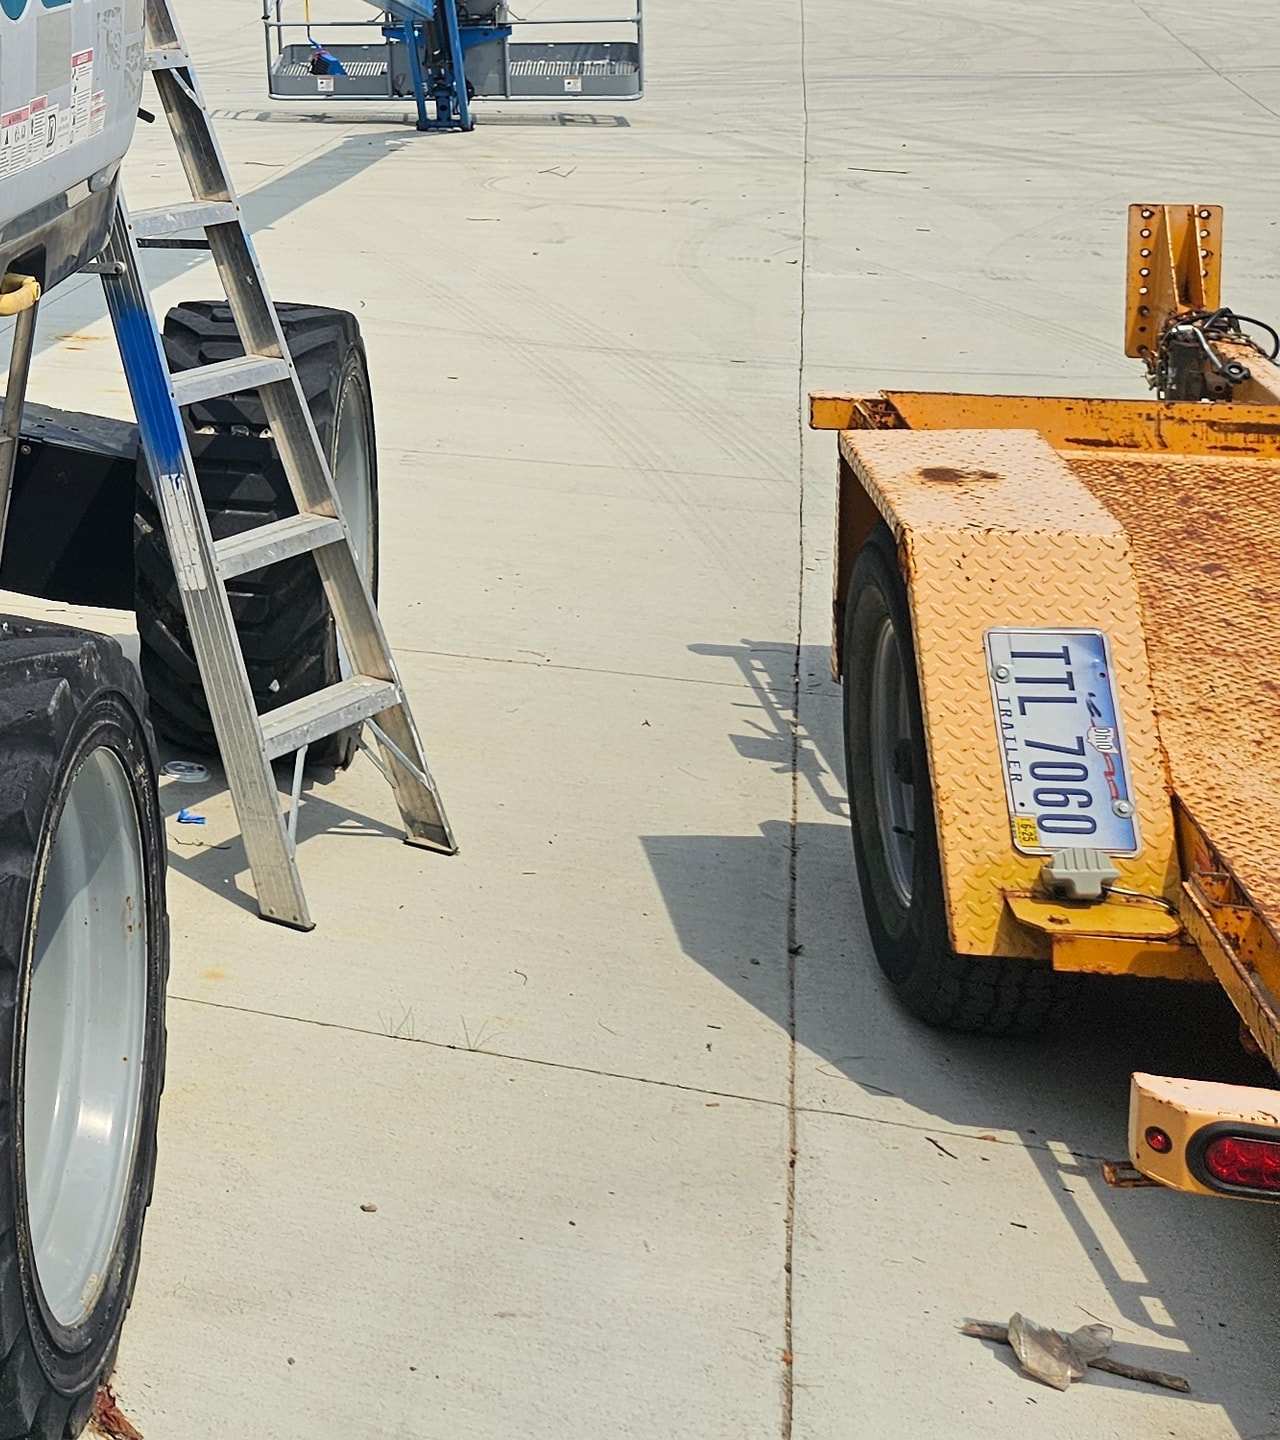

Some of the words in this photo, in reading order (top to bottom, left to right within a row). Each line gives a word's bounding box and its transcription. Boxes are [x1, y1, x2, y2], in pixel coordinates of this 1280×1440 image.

[1010, 646, 1078, 716] TTL
[998, 696, 1023, 783] TRAILER
[1024, 735, 1097, 835] 7060
